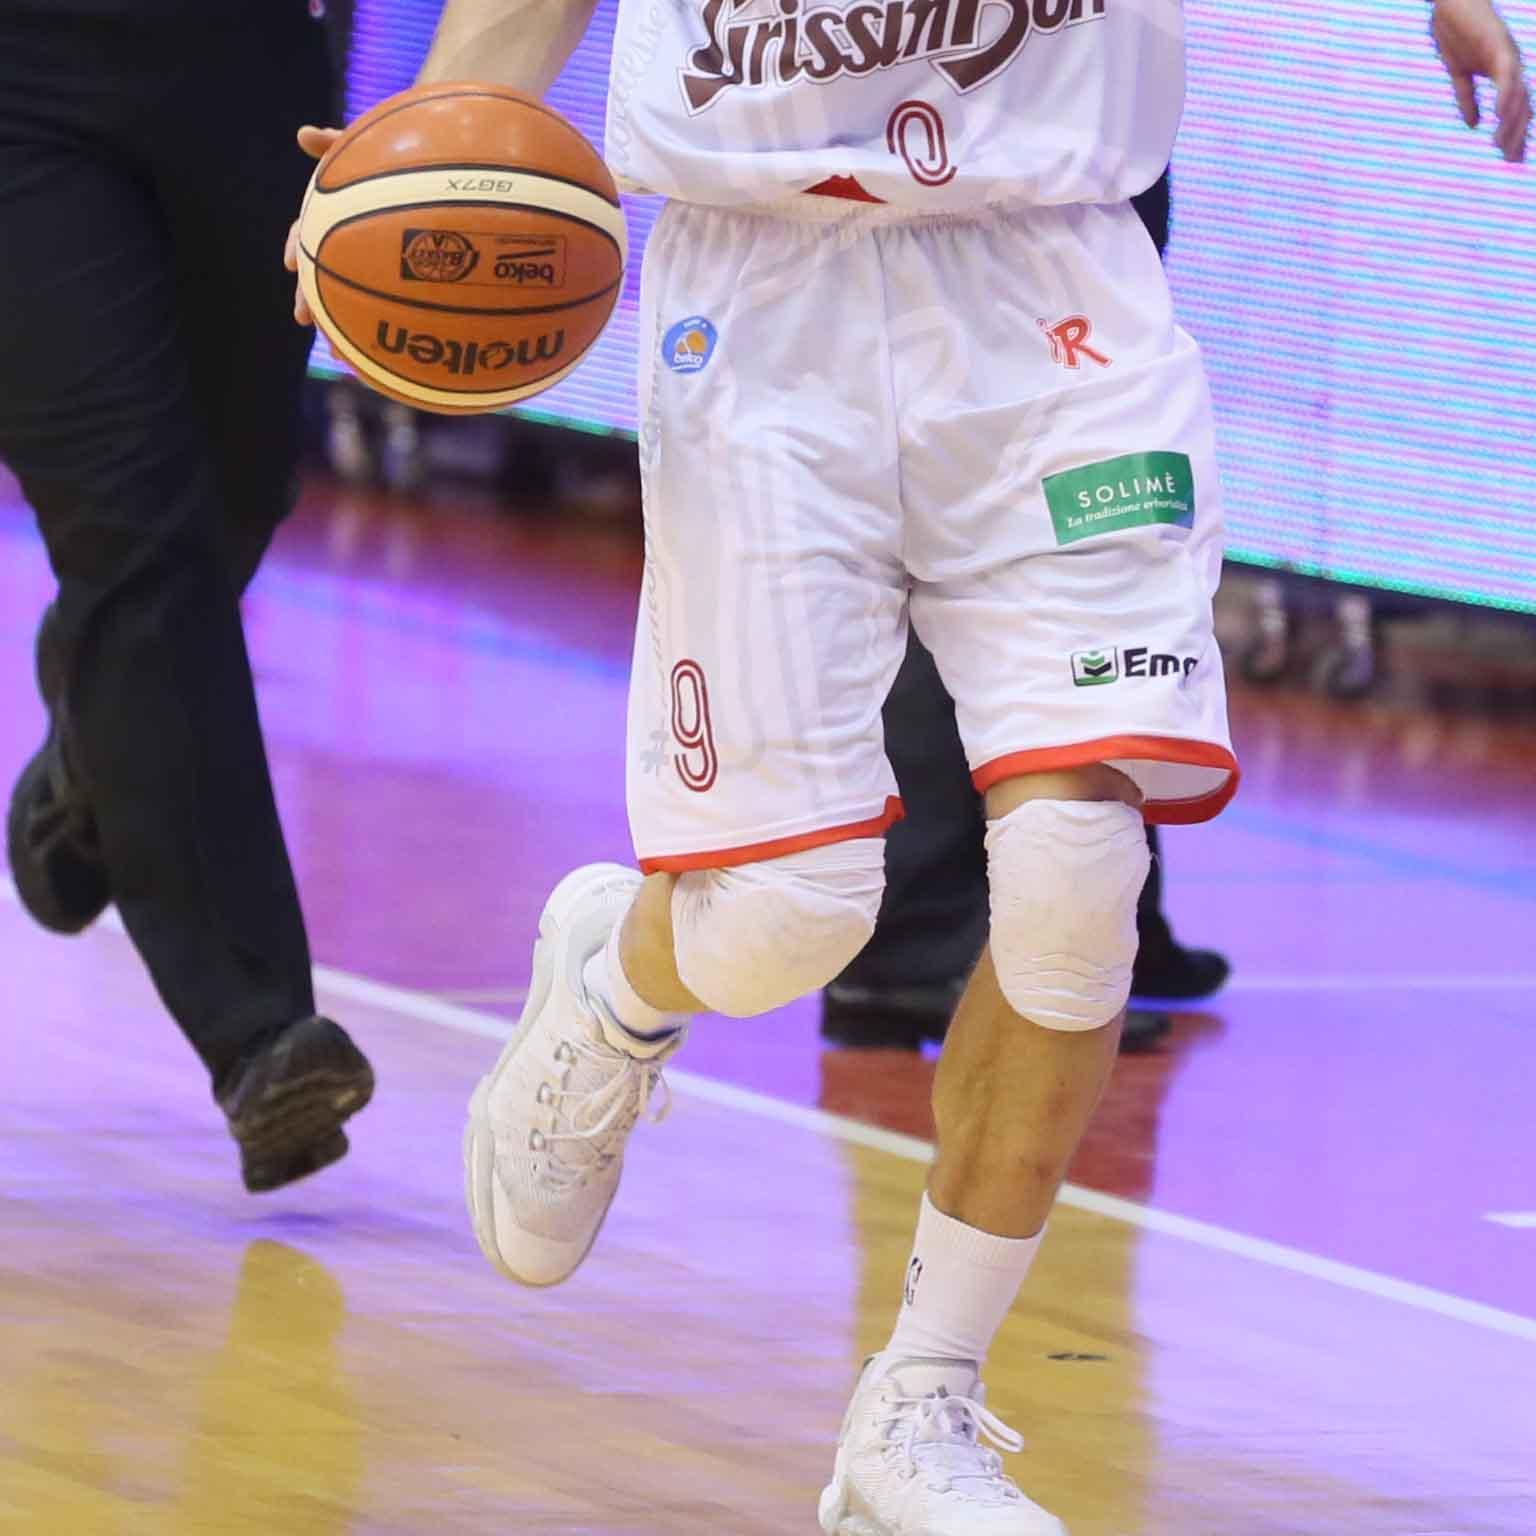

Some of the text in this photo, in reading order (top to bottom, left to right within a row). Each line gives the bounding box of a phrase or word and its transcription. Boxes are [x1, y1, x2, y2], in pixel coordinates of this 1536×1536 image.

[446, 176, 514, 194] GG7X
[494, 262, 555, 285] beko
[376, 320, 566, 376] molten
[1066, 516, 1083, 529] La
[1085, 502, 1141, 522] tradizione
[671, 658, 718, 793] 9
